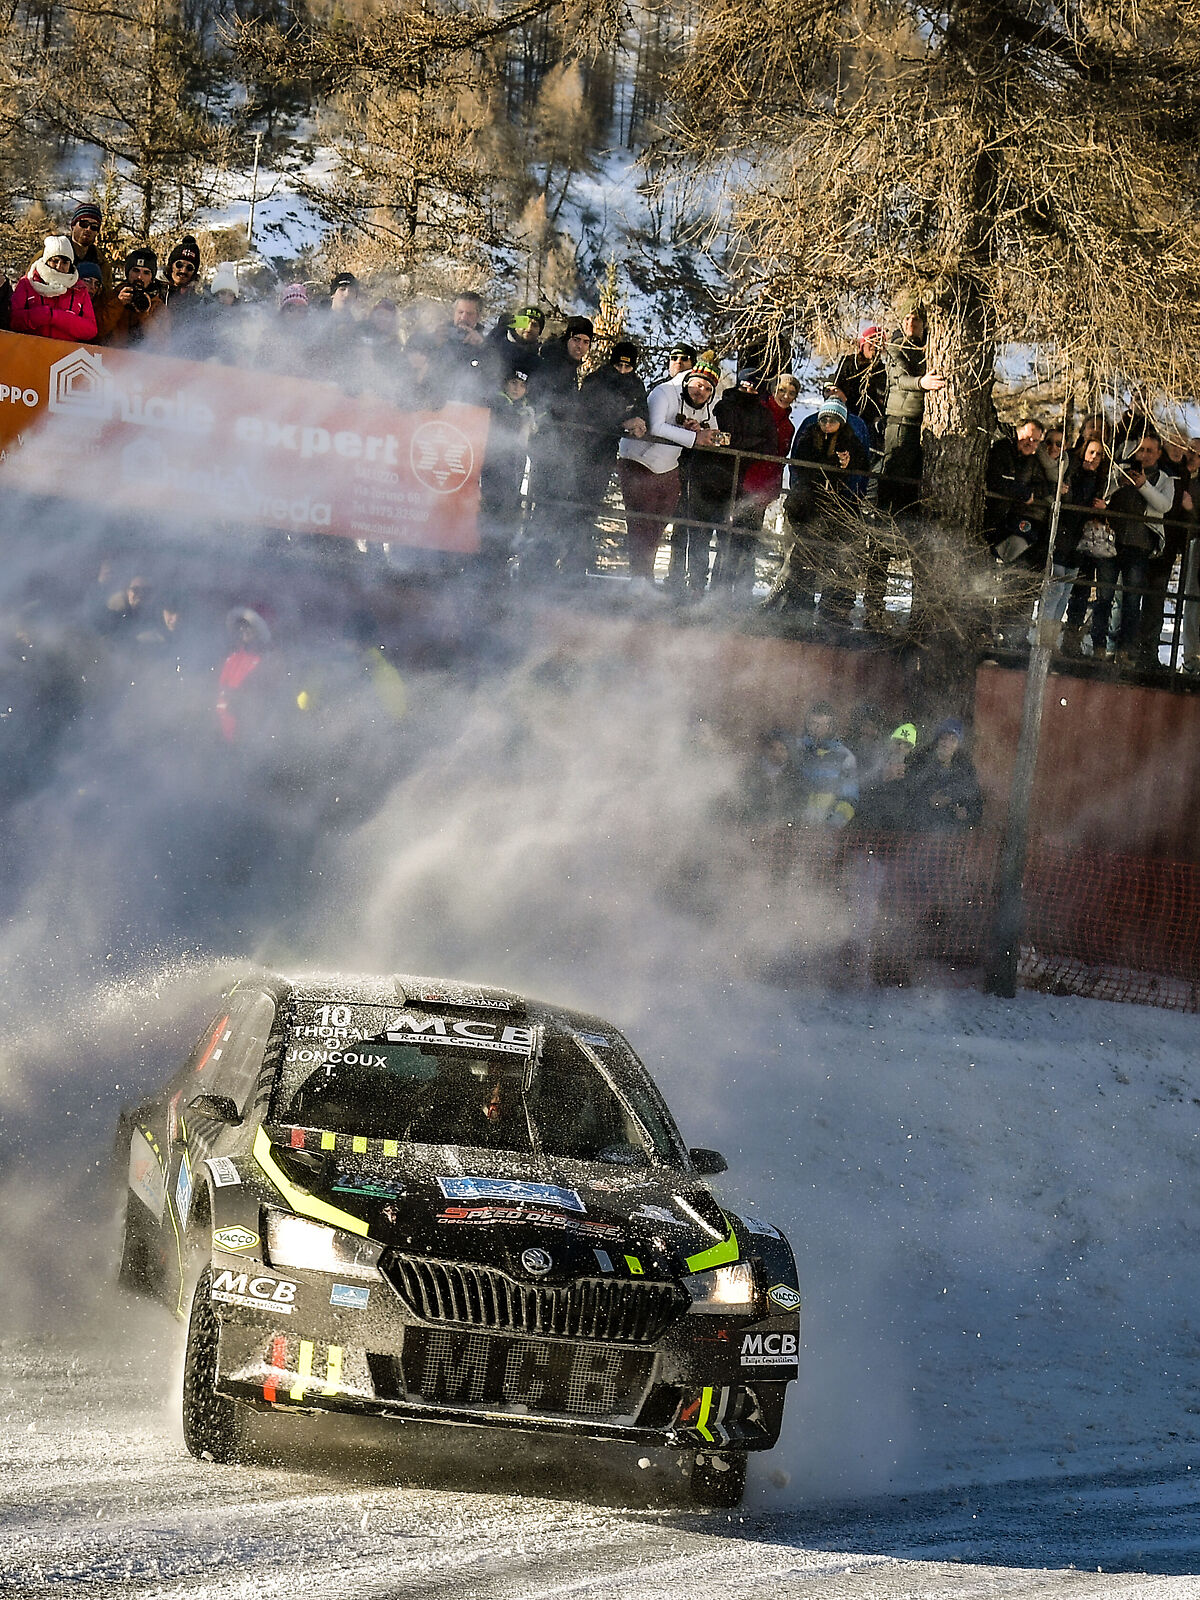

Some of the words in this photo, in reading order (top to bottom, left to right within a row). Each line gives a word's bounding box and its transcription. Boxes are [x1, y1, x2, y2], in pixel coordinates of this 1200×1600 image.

[234, 415, 400, 466] expert
[314, 1004, 352, 1027] 10
[293, 1025, 376, 1041] THORAL
[386, 1014, 533, 1046] MCB
[286, 1049, 388, 1069] JONCOUX
[322, 1063, 338, 1077] T.
[219, 1232, 254, 1244] YACCO
[212, 1270, 298, 1303] MCB
[771, 1290, 799, 1303] YACCO
[740, 1333, 797, 1355] MCB
[421, 1330, 622, 1414] MCB
